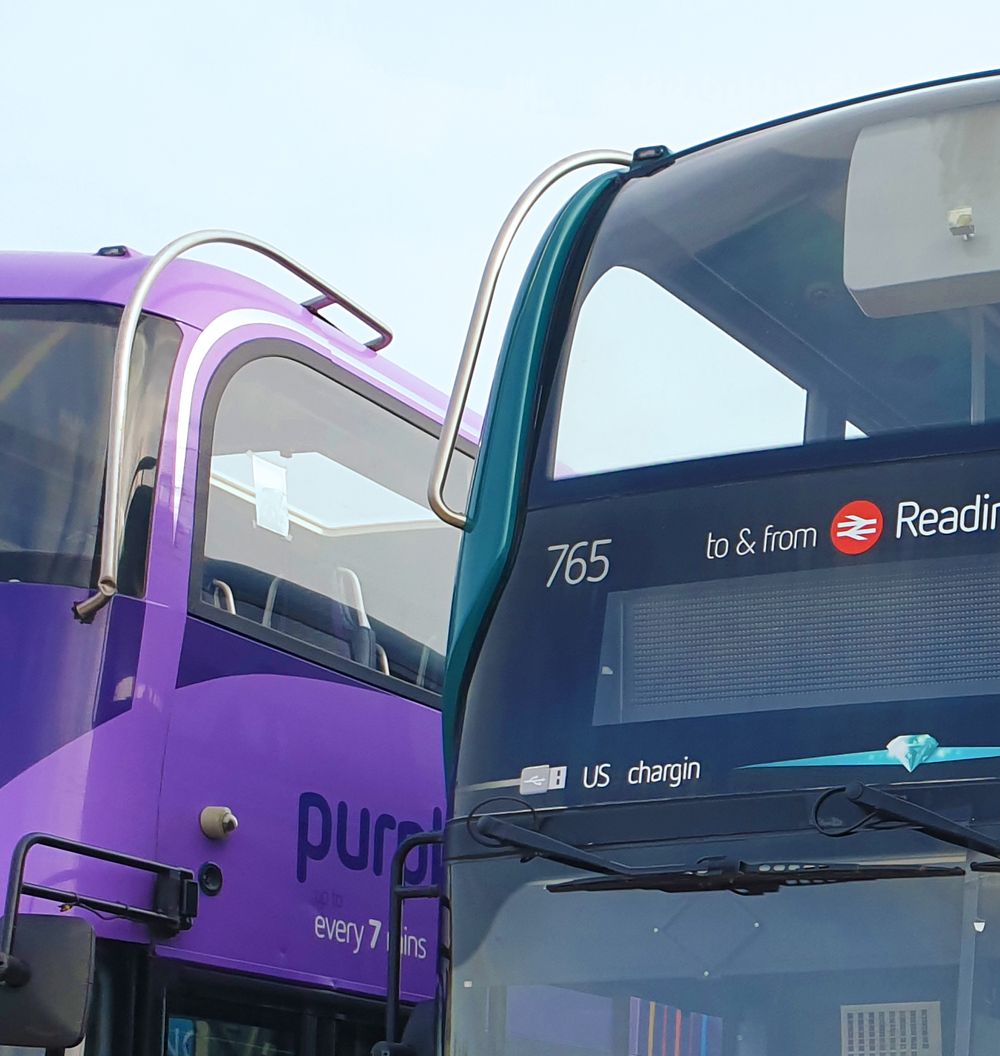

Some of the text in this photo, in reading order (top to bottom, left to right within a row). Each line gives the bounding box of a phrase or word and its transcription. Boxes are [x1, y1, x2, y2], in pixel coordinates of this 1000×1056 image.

[706, 524, 817, 560] to & from
[546, 539, 613, 588] 765
[628, 757, 701, 788] chargin
[314, 915, 364, 954] every
[368, 919, 382, 949] 7
